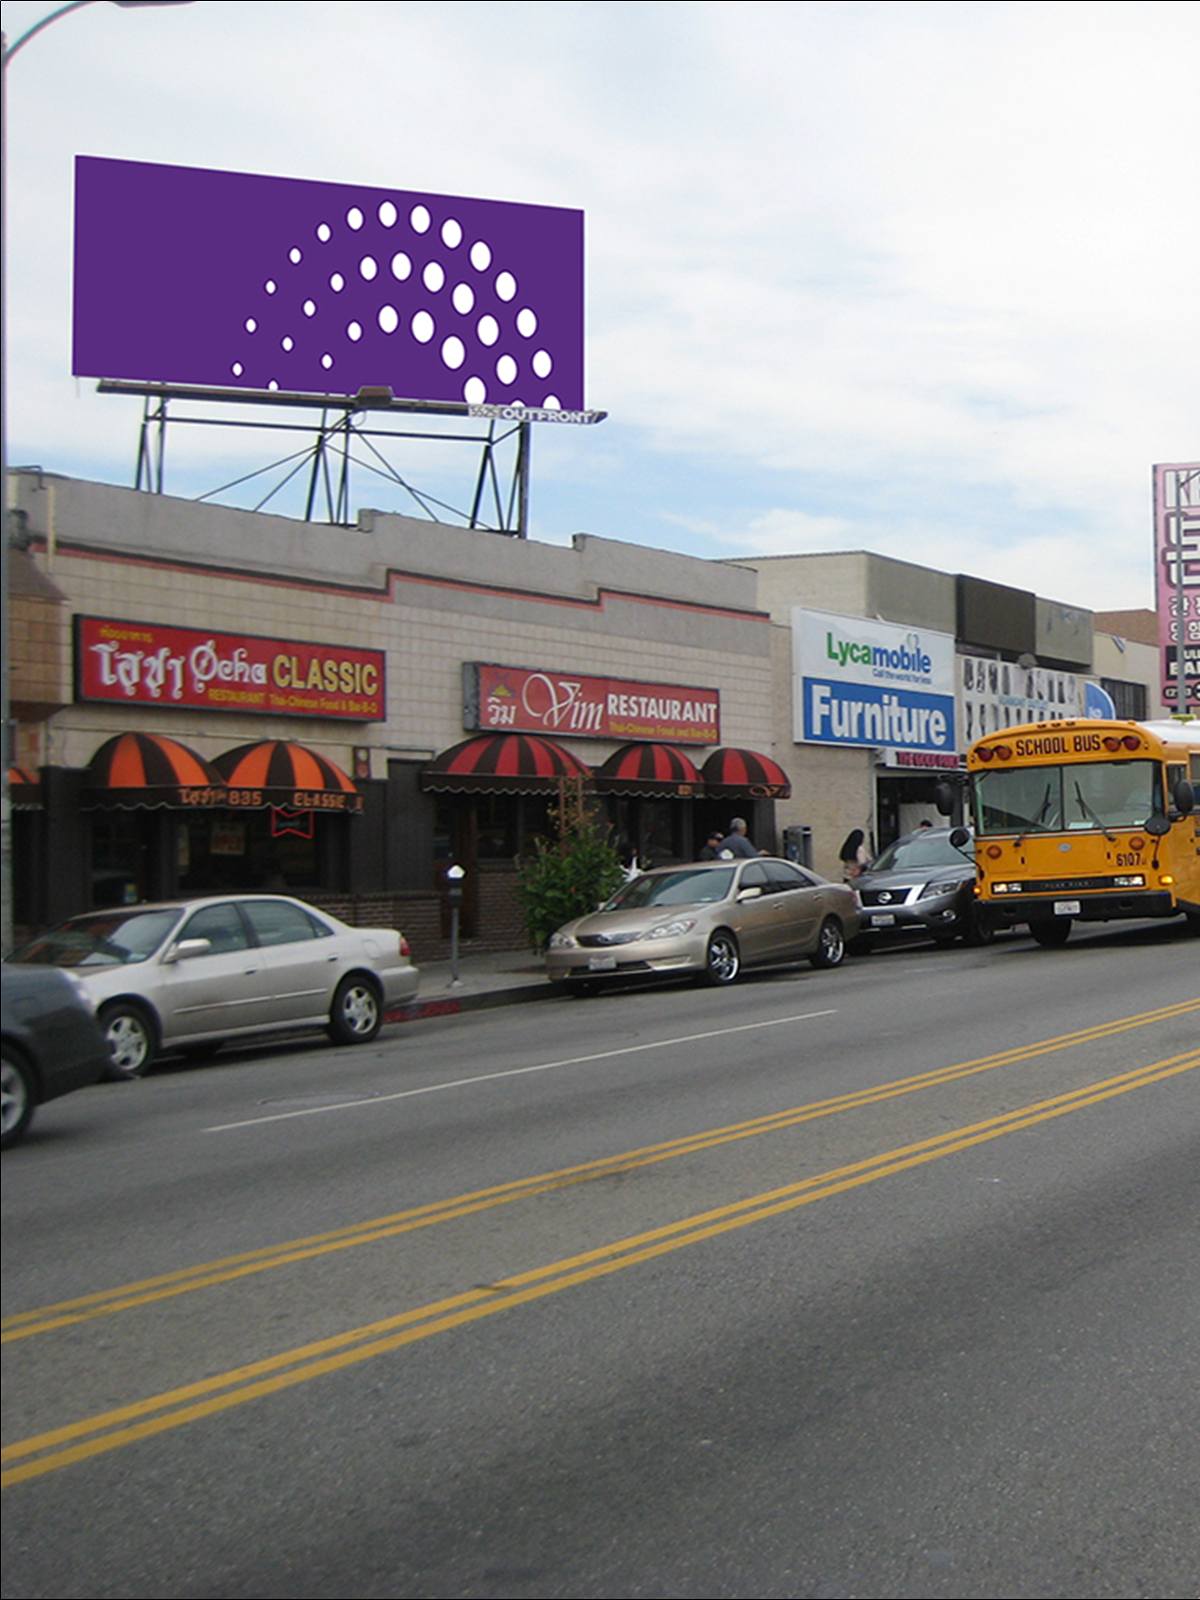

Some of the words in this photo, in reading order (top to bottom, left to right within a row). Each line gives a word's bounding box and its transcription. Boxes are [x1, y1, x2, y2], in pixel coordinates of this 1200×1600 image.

[826, 631, 932, 674] Lycamobile
[208, 688, 266, 704] RESTAURANT
[272, 654, 379, 697] CLASSIC
[521, 673, 605, 731] Vim
[607, 693, 719, 724] RESTAURANT
[811, 684, 947, 746] Furniture
[1016, 736, 1069, 757] SCHOOL
[1073, 733, 1101, 752] BUS
[1116, 852, 1141, 867] 6107
